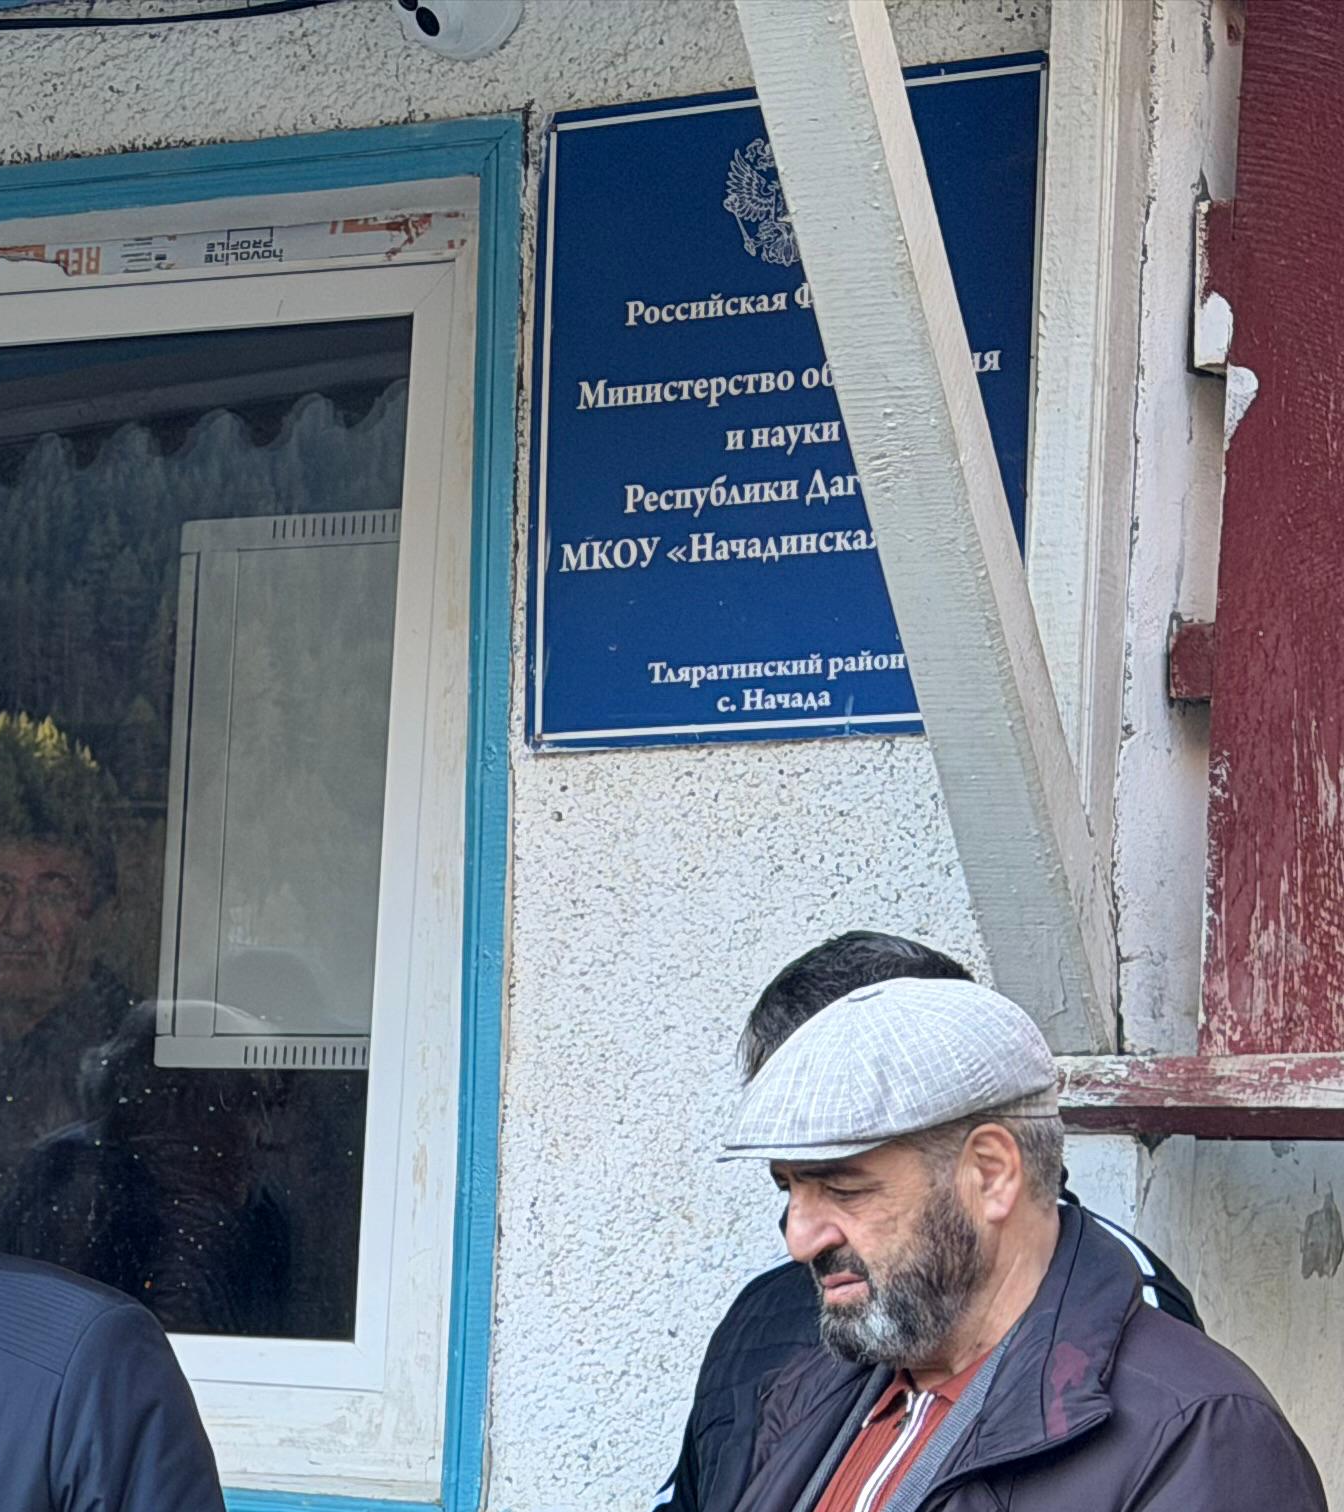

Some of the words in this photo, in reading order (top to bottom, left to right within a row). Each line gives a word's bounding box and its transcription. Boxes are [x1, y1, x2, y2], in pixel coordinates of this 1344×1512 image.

[625, 291, 787, 327] Российская
[575, 366, 795, 411] Министерство
[725, 430, 745, 451] и
[750, 420, 841, 455] науки
[623, 474, 800, 518] Республики
[558, 535, 662, 573] МКОУ
[647, 653, 823, 689] Тляратинский
[716, 695, 738, 713] с.
[741, 688, 832, 713] Начада
